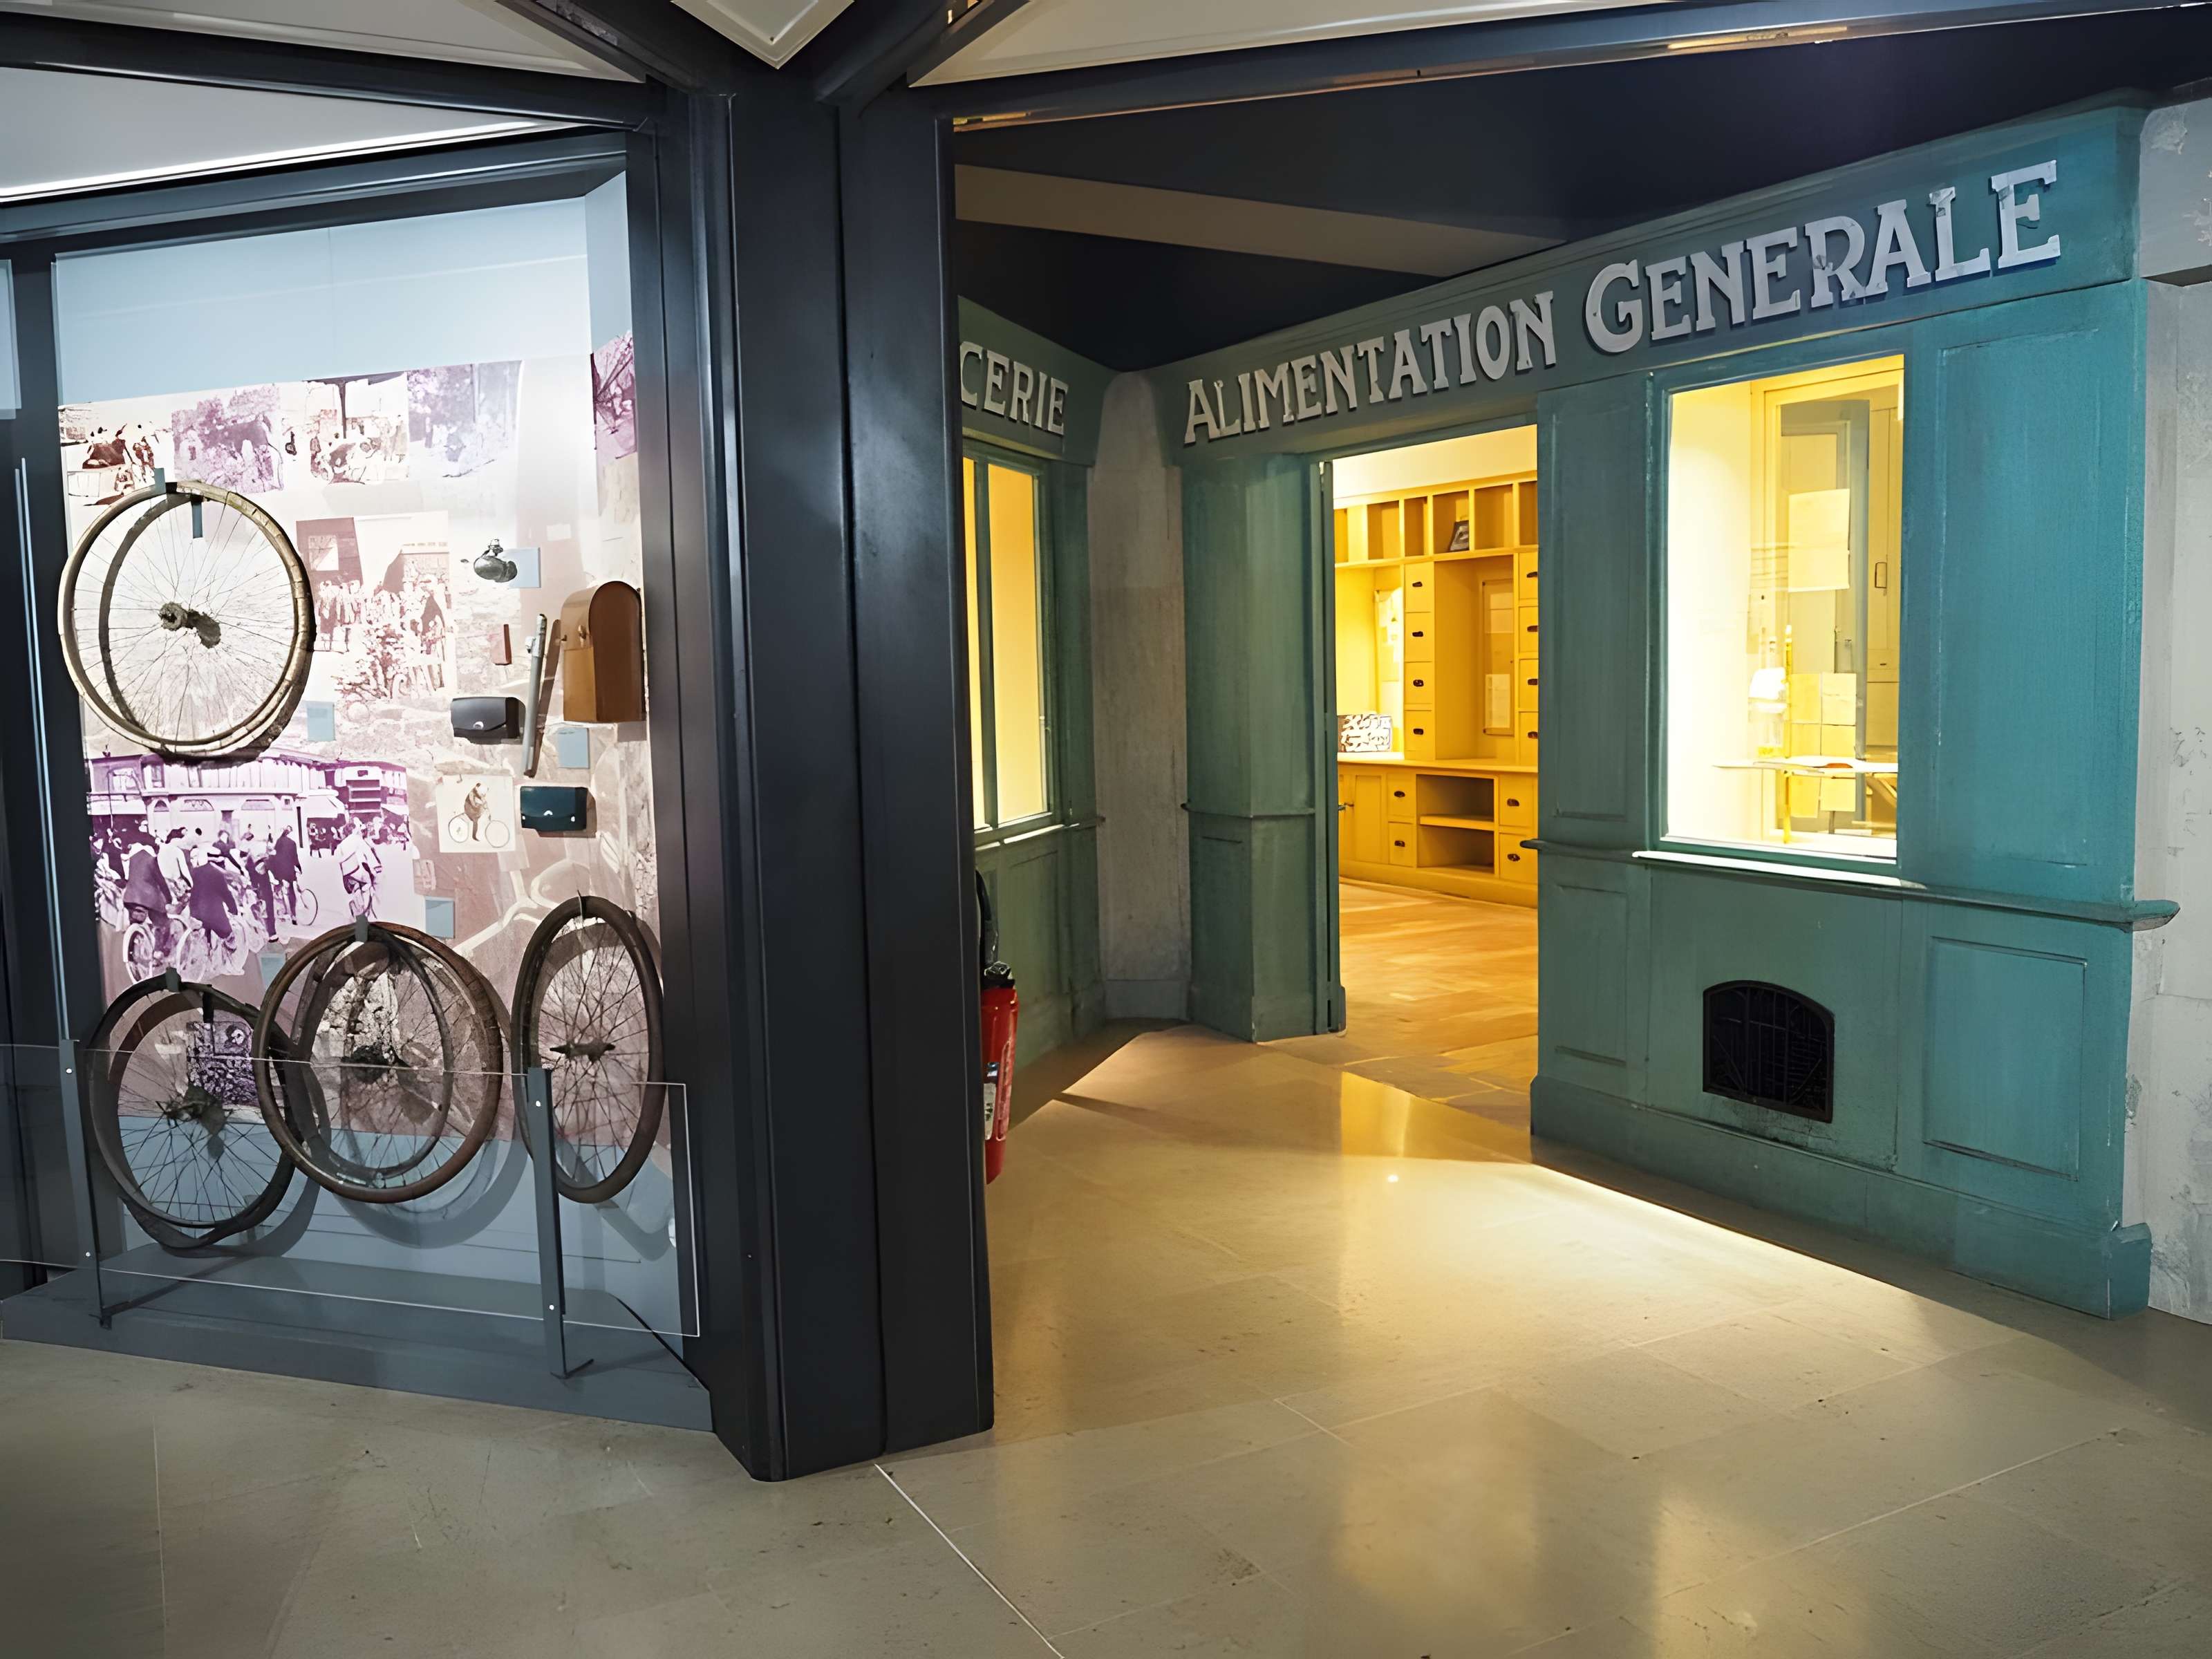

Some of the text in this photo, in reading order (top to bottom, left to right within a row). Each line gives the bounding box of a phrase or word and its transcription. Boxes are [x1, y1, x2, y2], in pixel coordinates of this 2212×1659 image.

[959, 341, 1069, 435] CERIE
[1183, 160, 2061, 444] ALIMENTATION GENERALE
